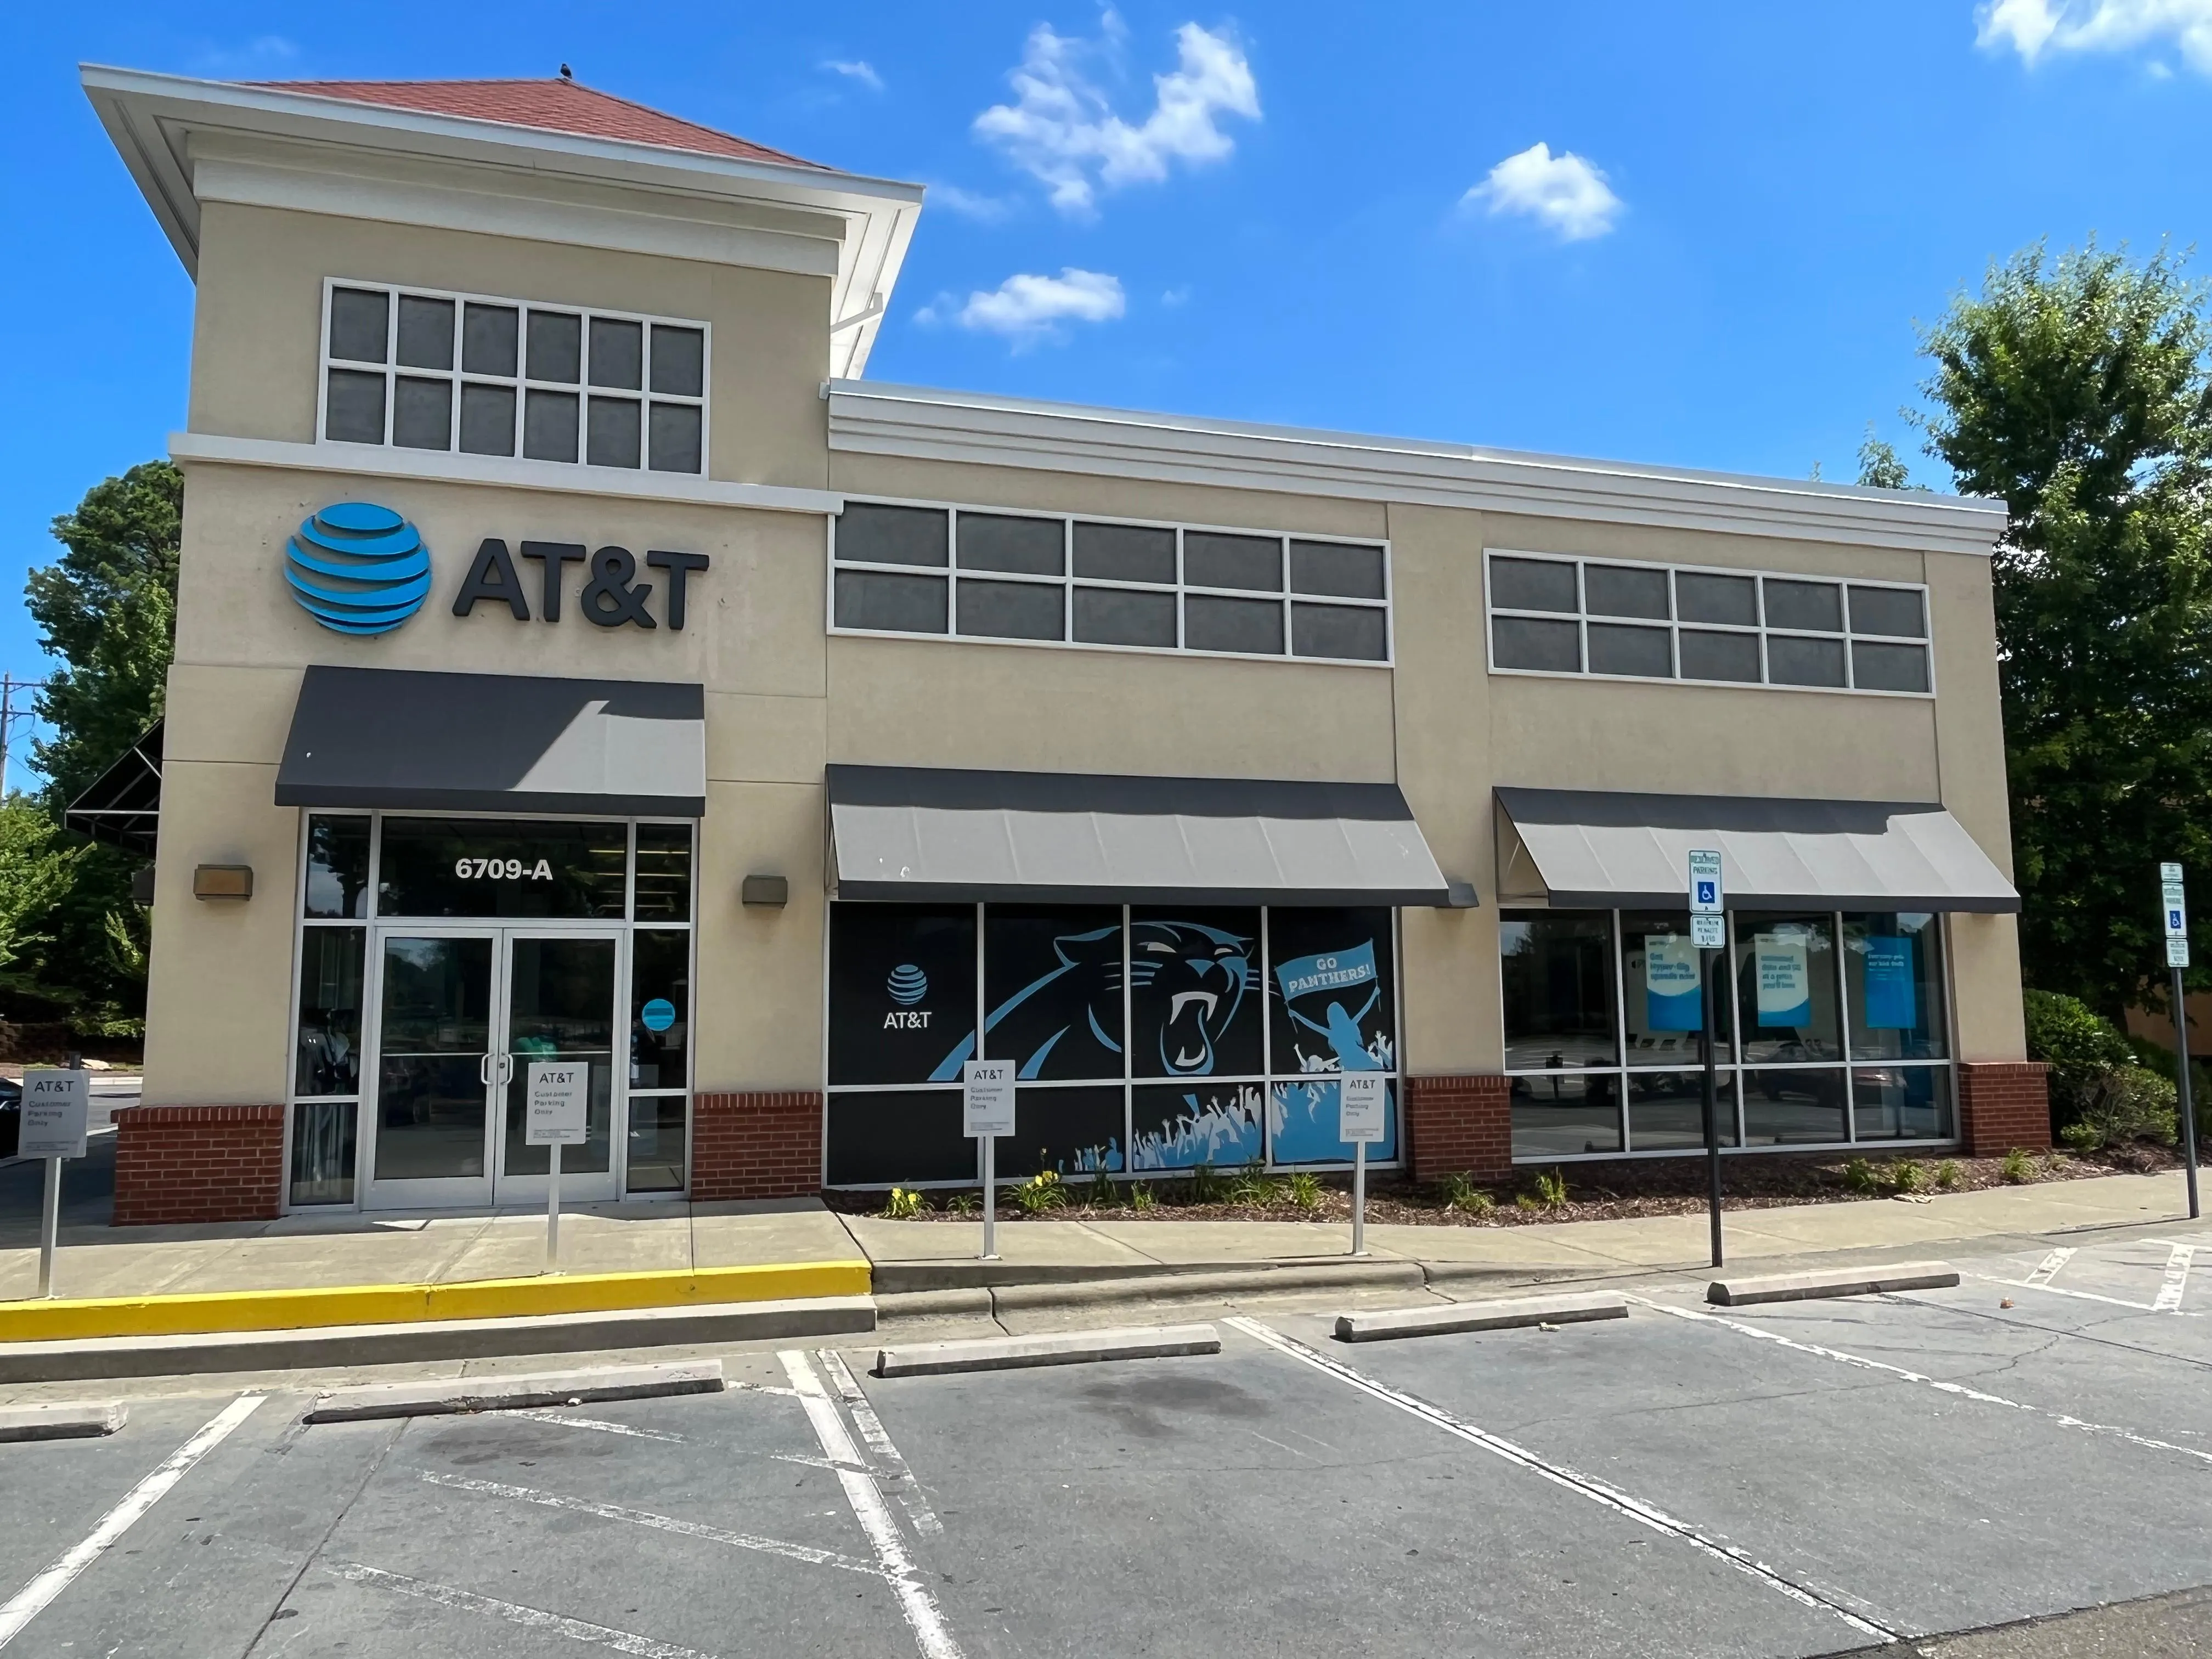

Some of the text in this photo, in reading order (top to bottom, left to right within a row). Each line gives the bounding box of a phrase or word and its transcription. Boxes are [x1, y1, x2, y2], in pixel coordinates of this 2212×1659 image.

[453, 538, 710, 630] AT&T
[455, 858, 553, 880] 6709-A
[1317, 957, 1338, 970] GO
[1289, 964, 1371, 993] PANTHERS!
[883, 1011, 932, 1029] AT&T
[539, 1072, 574, 1084] AT&T
[974, 1069, 1003, 1080] AT&T
[35, 1081, 75, 1092] AT&T
[1350, 1079, 1375, 1089] AT&T
